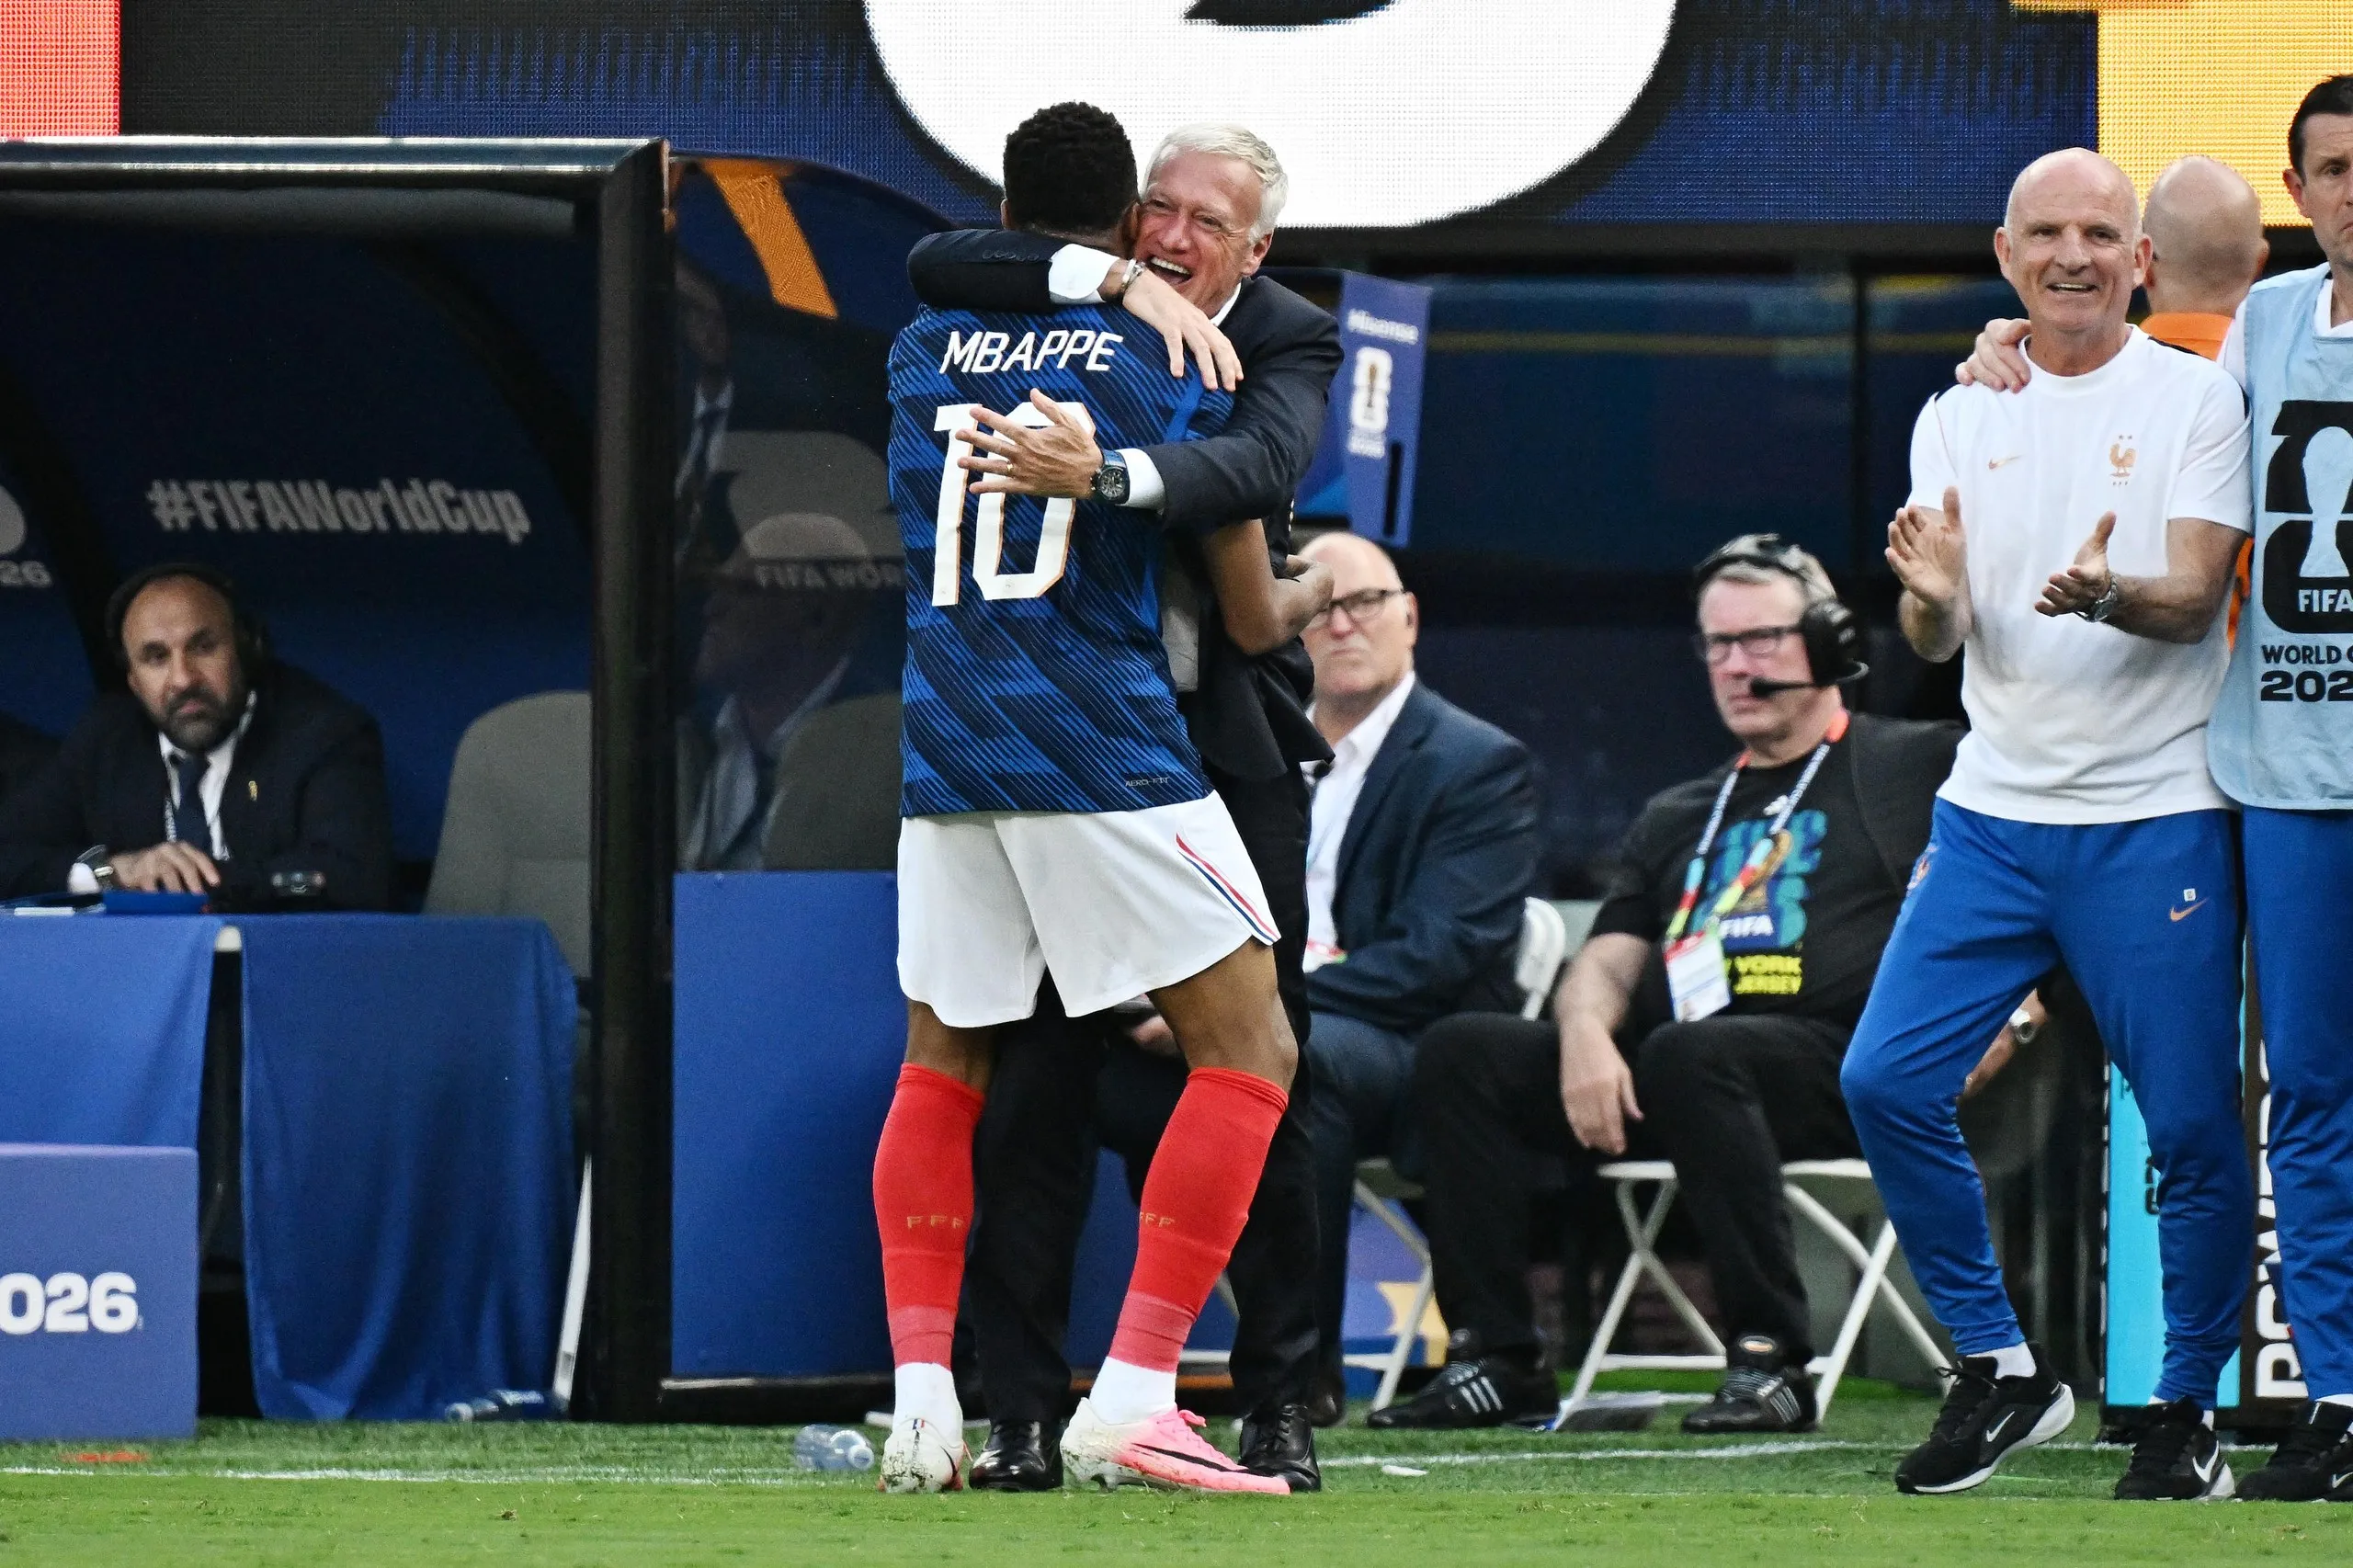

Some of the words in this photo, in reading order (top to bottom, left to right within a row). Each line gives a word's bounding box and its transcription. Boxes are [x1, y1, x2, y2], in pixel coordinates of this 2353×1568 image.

[939, 329, 1124, 374] MBAPPE
[146, 478, 532, 545] #FIFAWorldCup
[932, 402, 1097, 607] 10
[2299, 589, 2353, 613] FIFA
[2260, 644, 2343, 665] WORLD
[2260, 669, 2353, 703] 202
[1719, 915, 1774, 938] FIFA
[1733, 954, 1802, 975] YORK
[1733, 974, 1802, 994] JERSEY
[0, 1271, 138, 1335] 026
